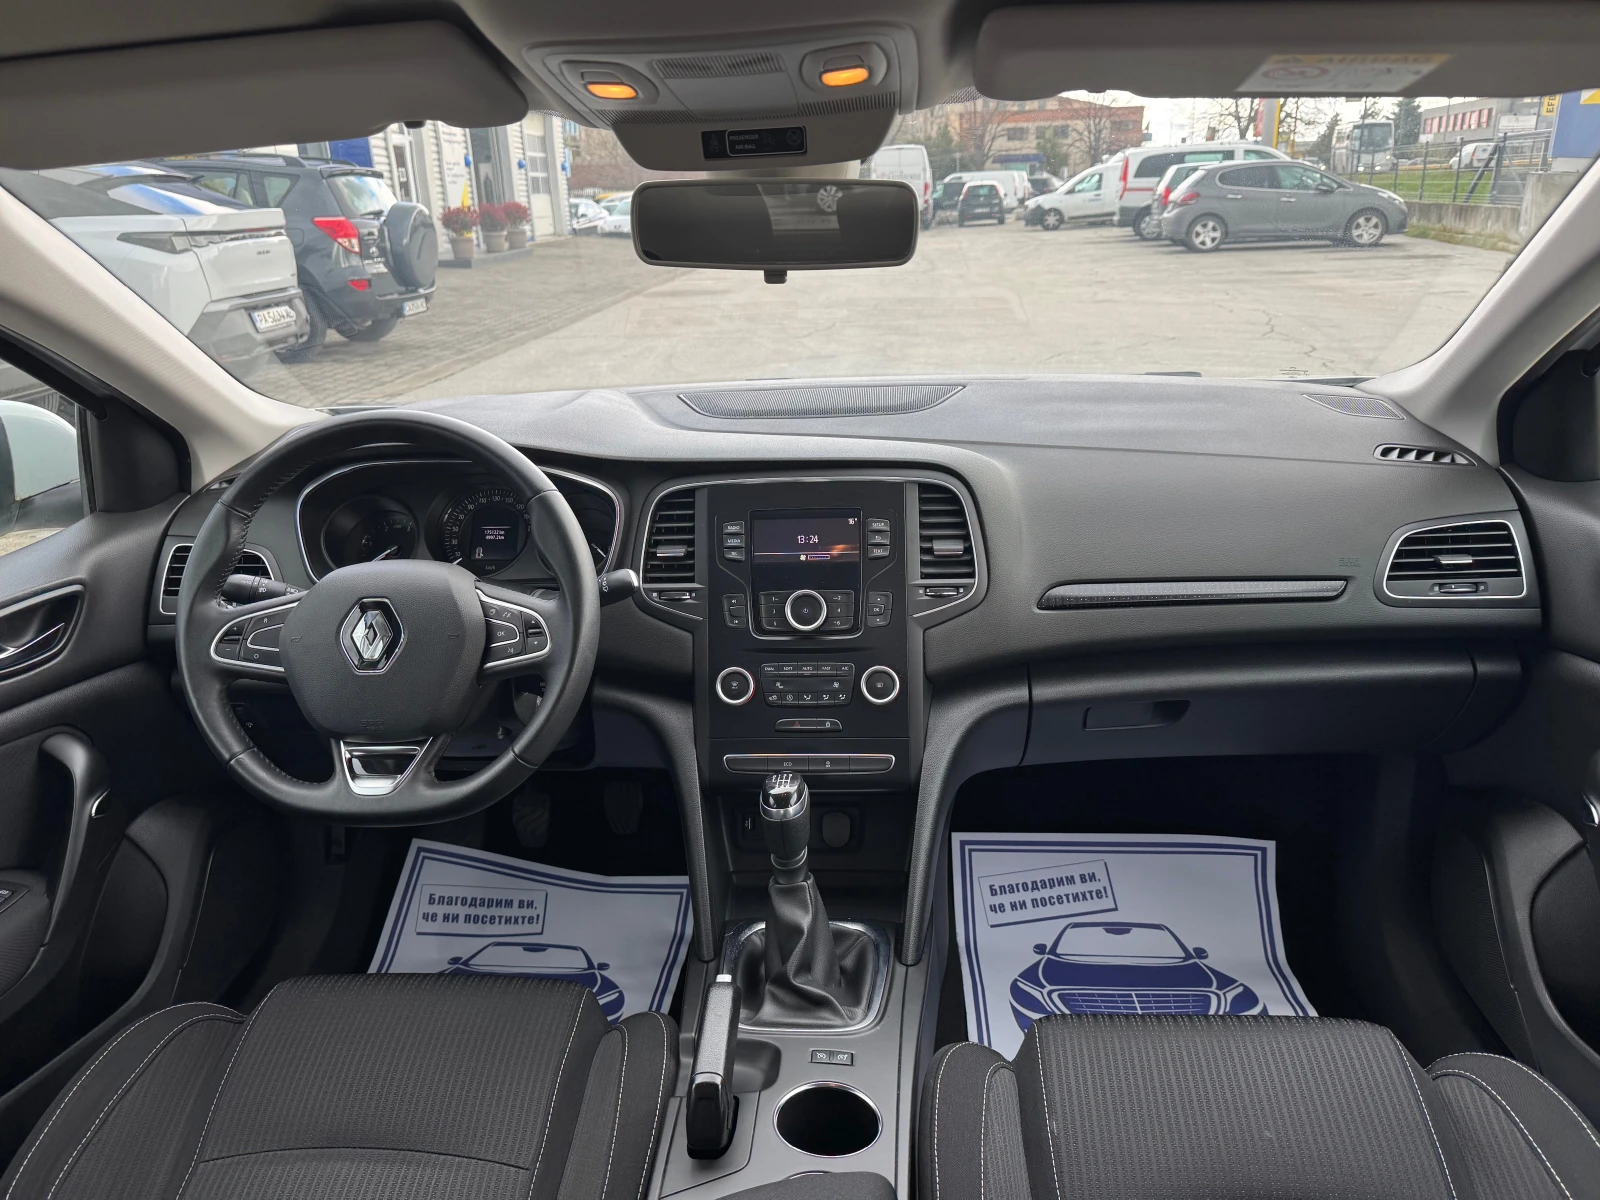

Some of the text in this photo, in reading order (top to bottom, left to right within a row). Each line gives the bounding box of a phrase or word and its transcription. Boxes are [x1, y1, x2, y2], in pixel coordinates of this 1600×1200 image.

[797, 535, 818, 544] 13:24
[988, 871, 1101, 897] Благодарим ви,
[428, 893, 538, 910] Благодарим ви,
[989, 886, 1109, 914] че ни посетихте!
[422, 911, 540, 925] че ни посетихте!
